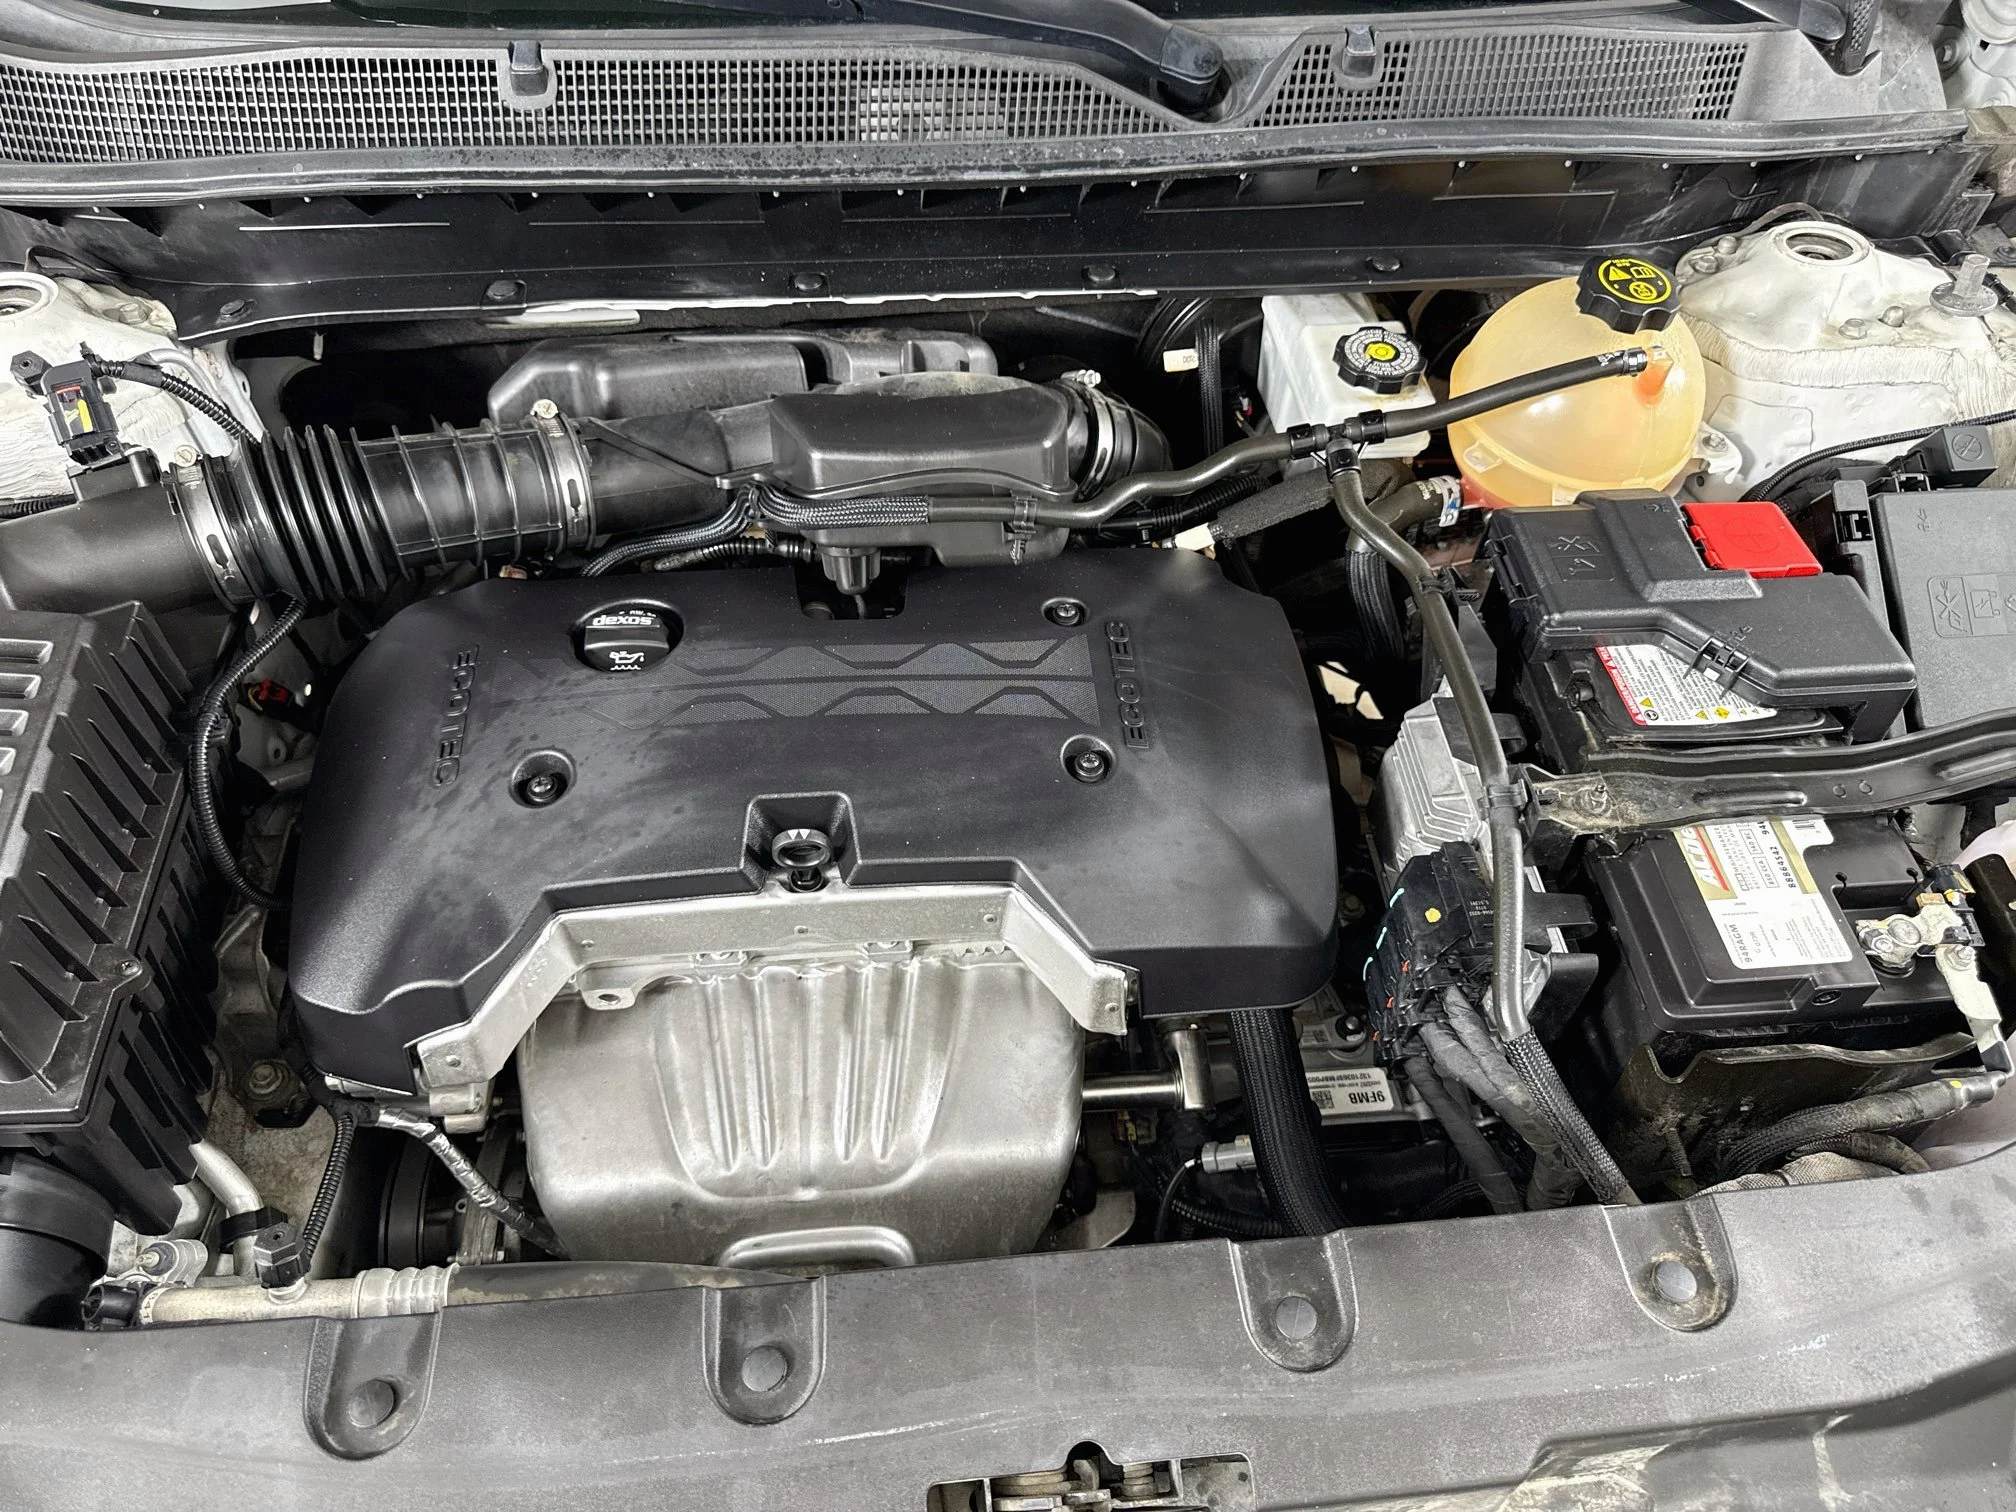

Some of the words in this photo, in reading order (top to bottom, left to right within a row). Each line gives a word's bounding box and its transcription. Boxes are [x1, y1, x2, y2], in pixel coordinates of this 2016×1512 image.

[593, 614, 654, 626] dexos
[1105, 620, 1149, 749] ECOTEC
[432, 645, 480, 787] ECOTEC
[1714, 827, 1740, 872] MAINTENANCE
[1770, 846, 1796, 888] 88864542
[1729, 924, 1753, 962] 94RAGM
[1349, 1090, 1385, 1104] 9FMB
